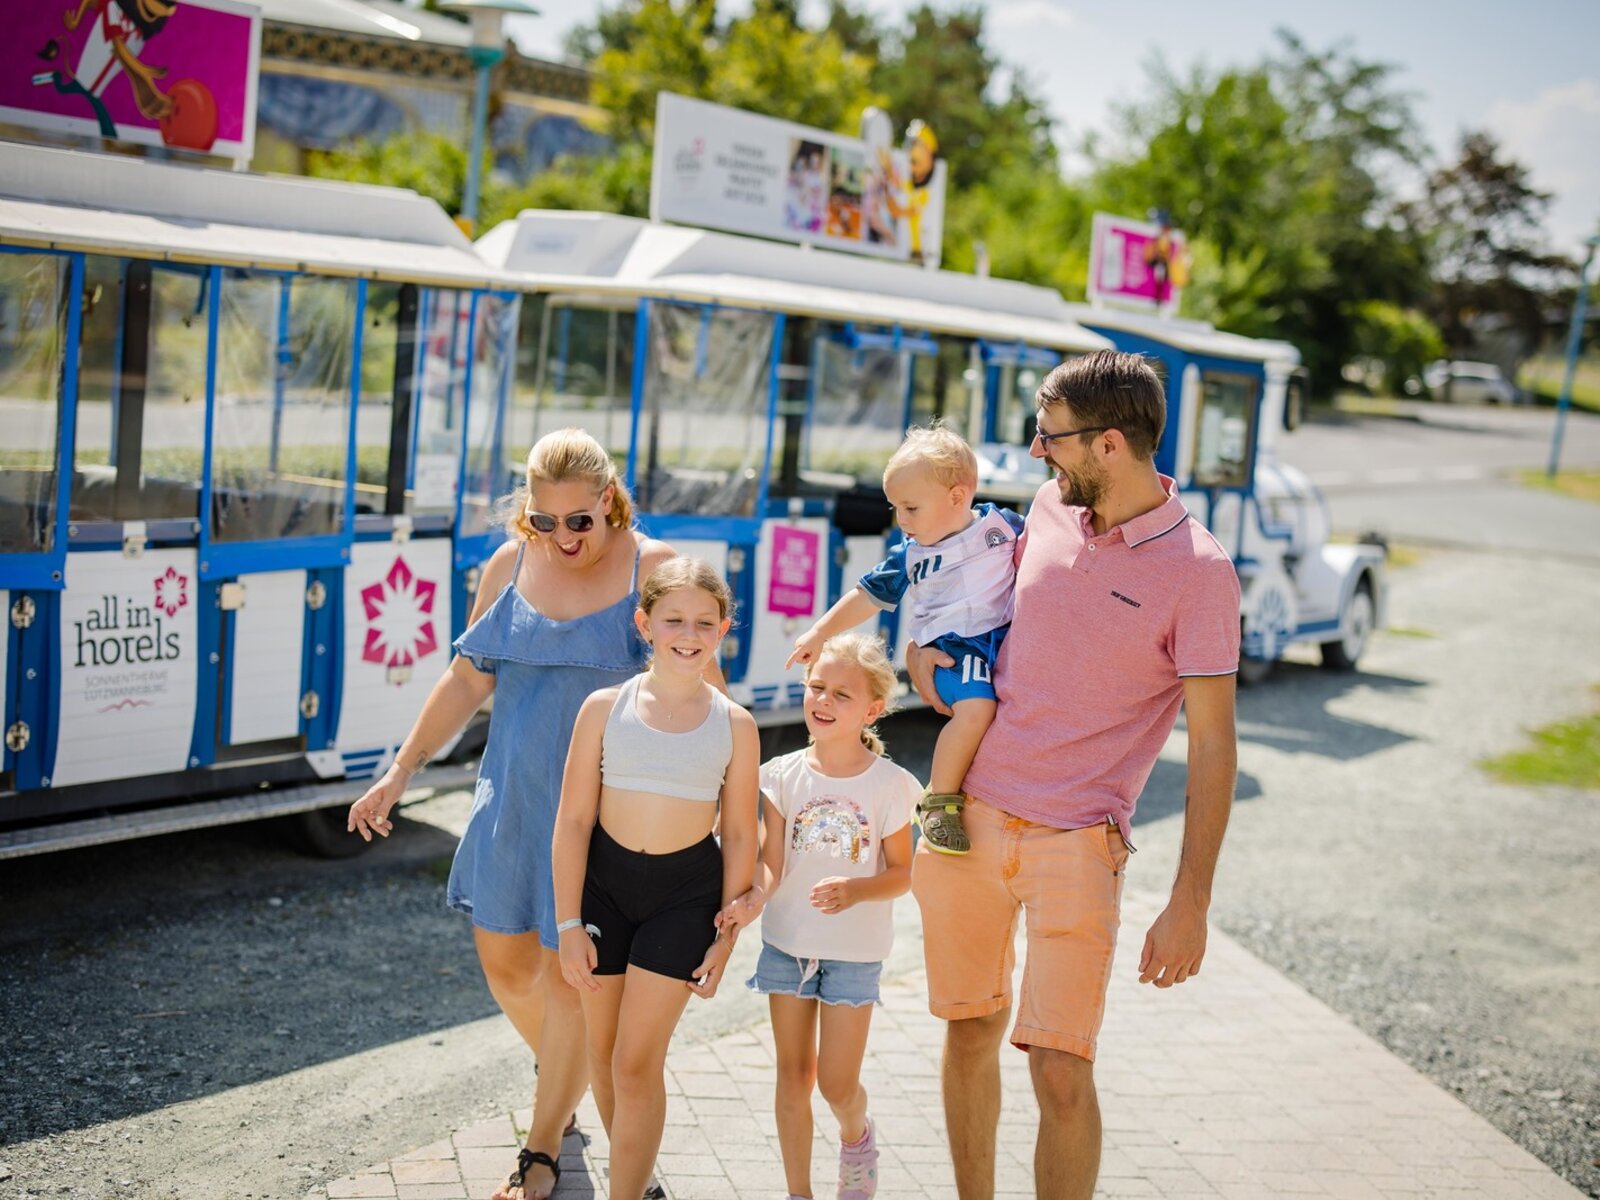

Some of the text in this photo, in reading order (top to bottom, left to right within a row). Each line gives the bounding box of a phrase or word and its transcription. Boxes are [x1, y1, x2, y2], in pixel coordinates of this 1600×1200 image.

[86, 594, 151, 631] all in
[74, 617, 180, 667] hotels
